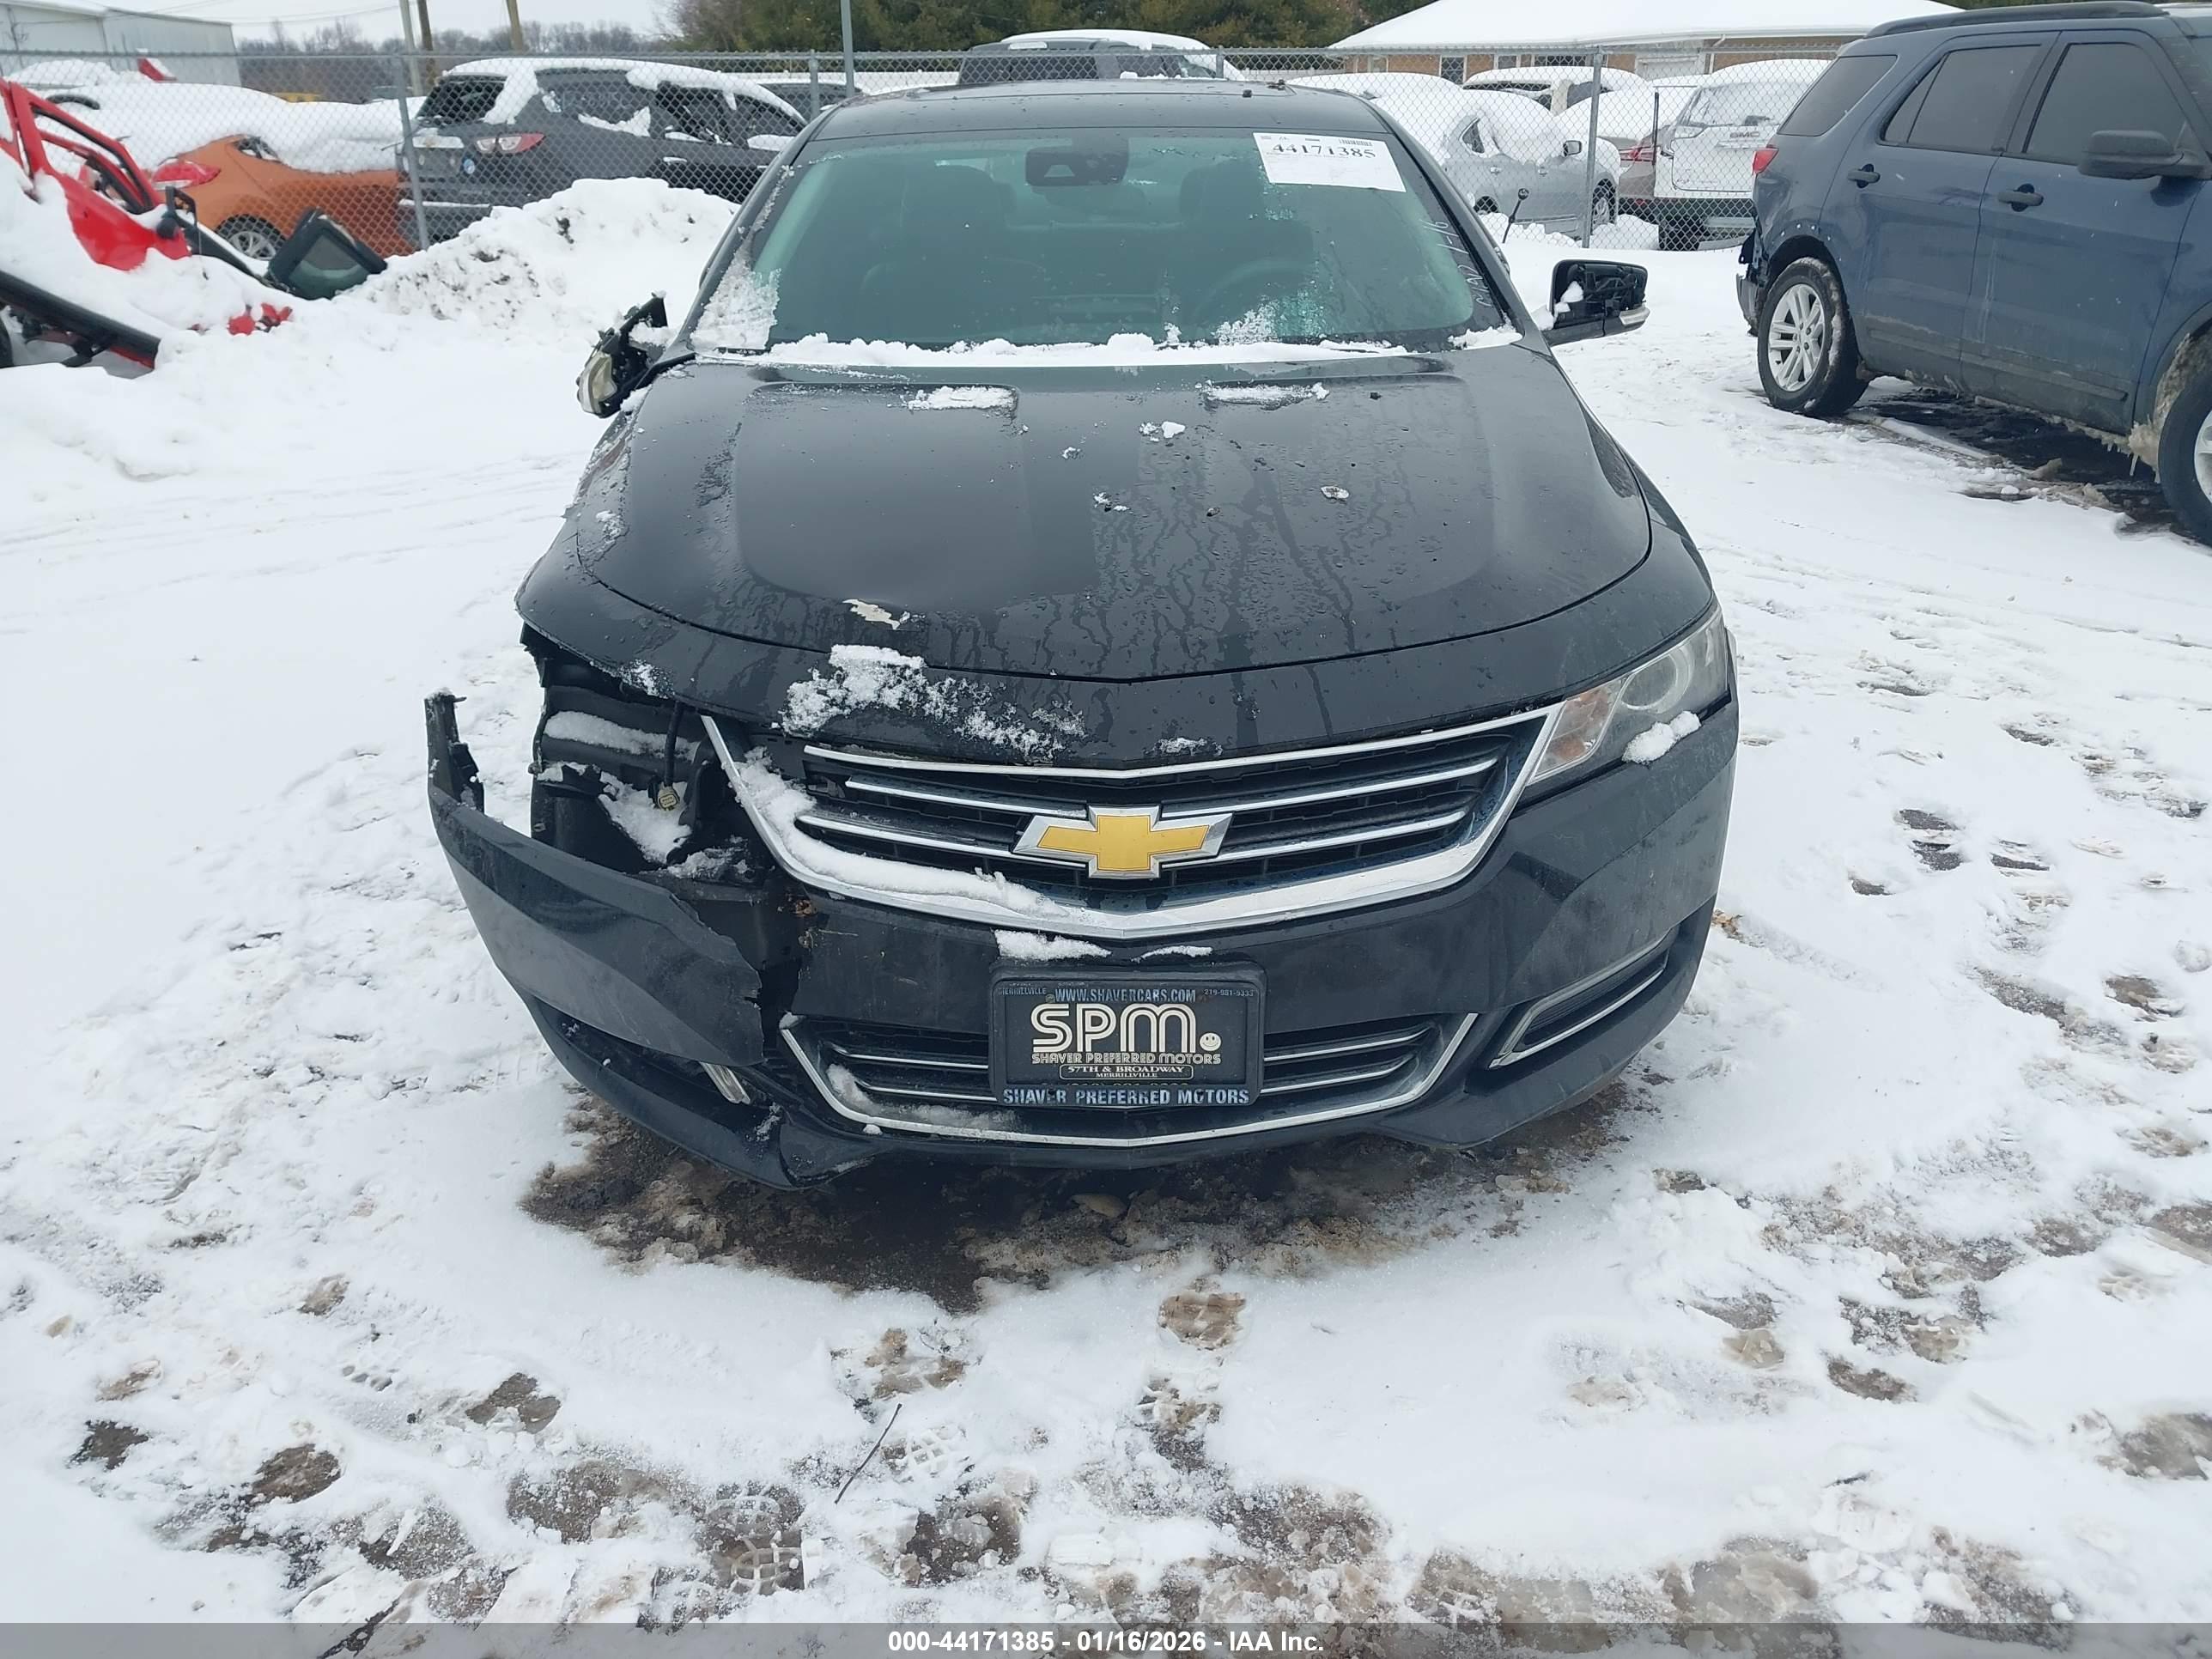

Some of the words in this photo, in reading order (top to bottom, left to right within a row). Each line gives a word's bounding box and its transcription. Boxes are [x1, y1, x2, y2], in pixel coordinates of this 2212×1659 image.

[1273, 143, 1376, 159] 44171385
[1054, 988, 1196, 1003] WWW.SHAVERCARS.COM
[1031, 1053, 1083, 1064] SHAVER
[1085, 1053, 1156, 1064] PREFERRED
[1158, 1053, 1221, 1064] MOTORS
[1075, 1089, 1170, 1105] PREFERRED
[1177, 1089, 1250, 1105] MOTORS
